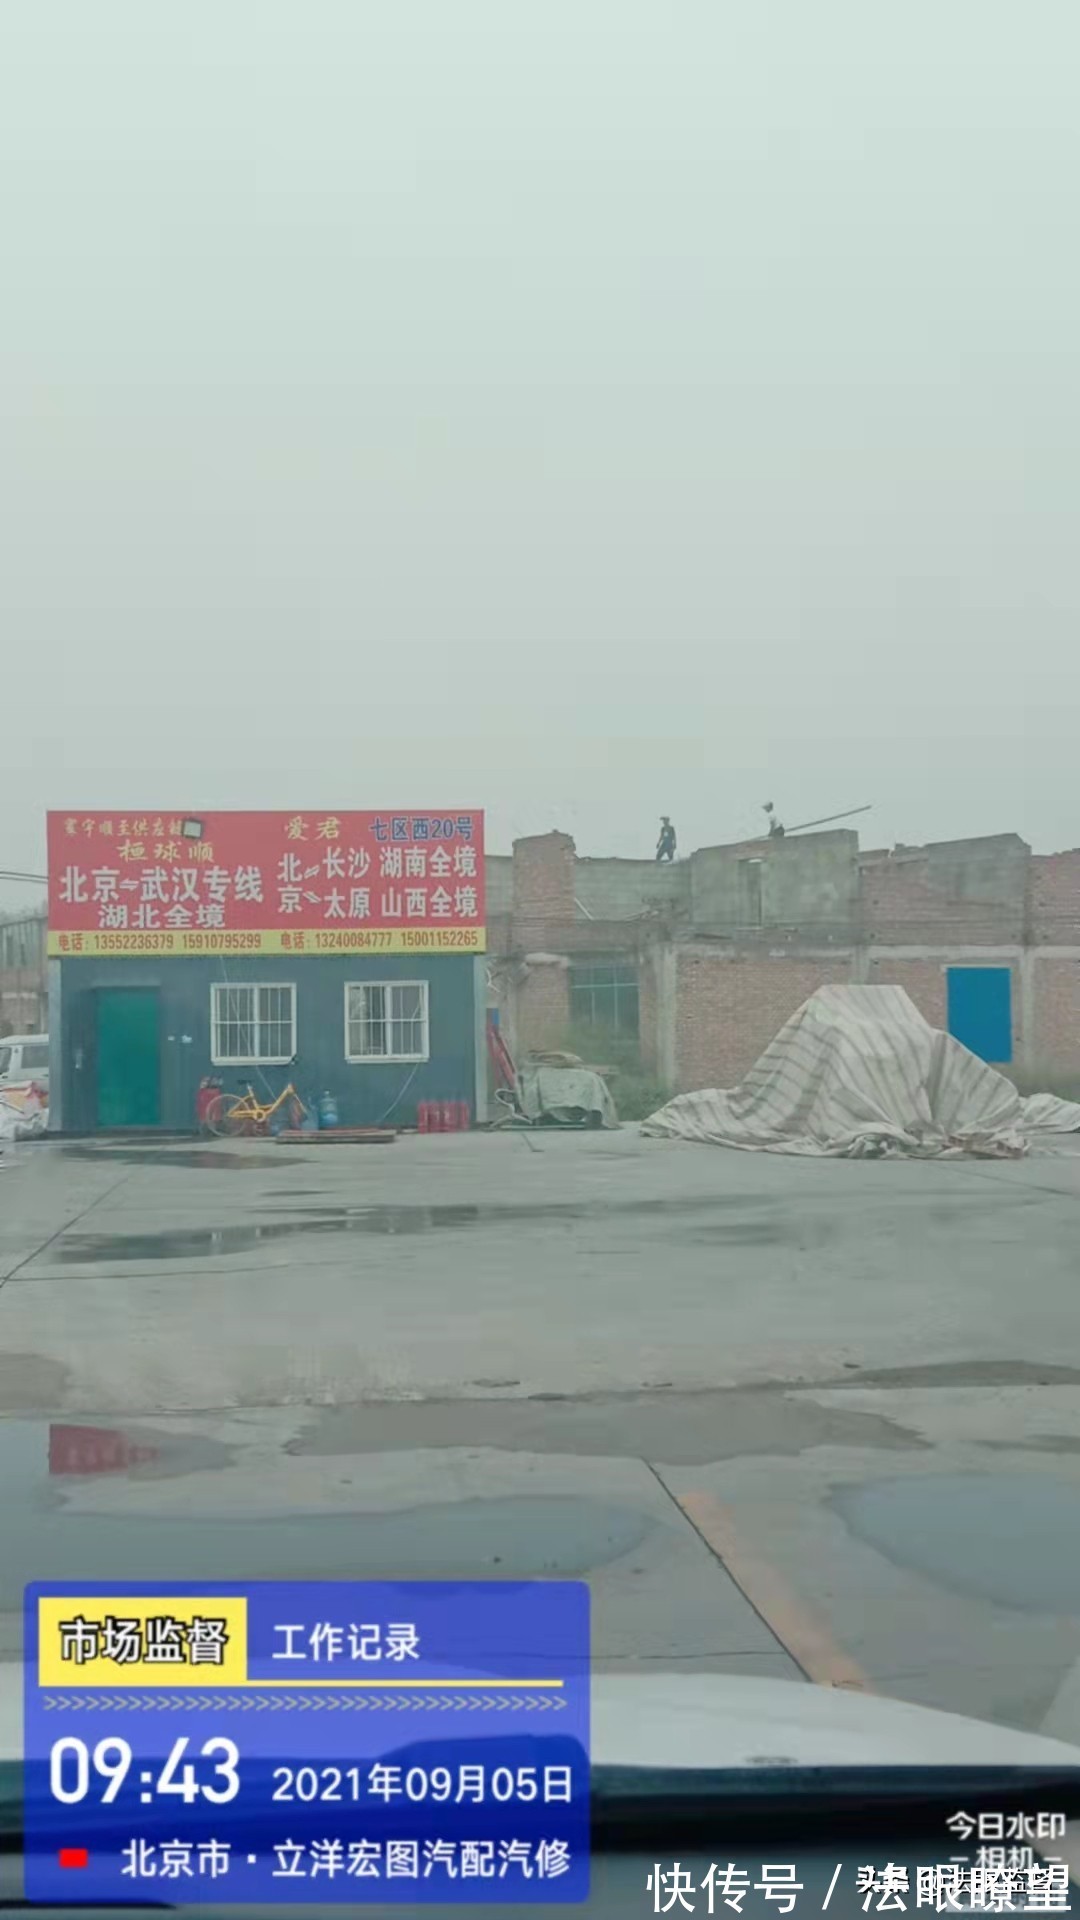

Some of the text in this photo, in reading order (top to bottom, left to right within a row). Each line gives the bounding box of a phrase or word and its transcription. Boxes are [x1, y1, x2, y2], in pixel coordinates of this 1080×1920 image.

[284, 816, 342, 841] 爱君
[370, 816, 473, 842] 七区西20号
[323, 846, 477, 879] 长沙 湖南全境
[324, 886, 478, 919] 太原 山西全境
[98, 904, 225, 929] 湖北全境
[183, 934, 262, 949] 15910795299
[401, 931, 478, 947] 15001152265
